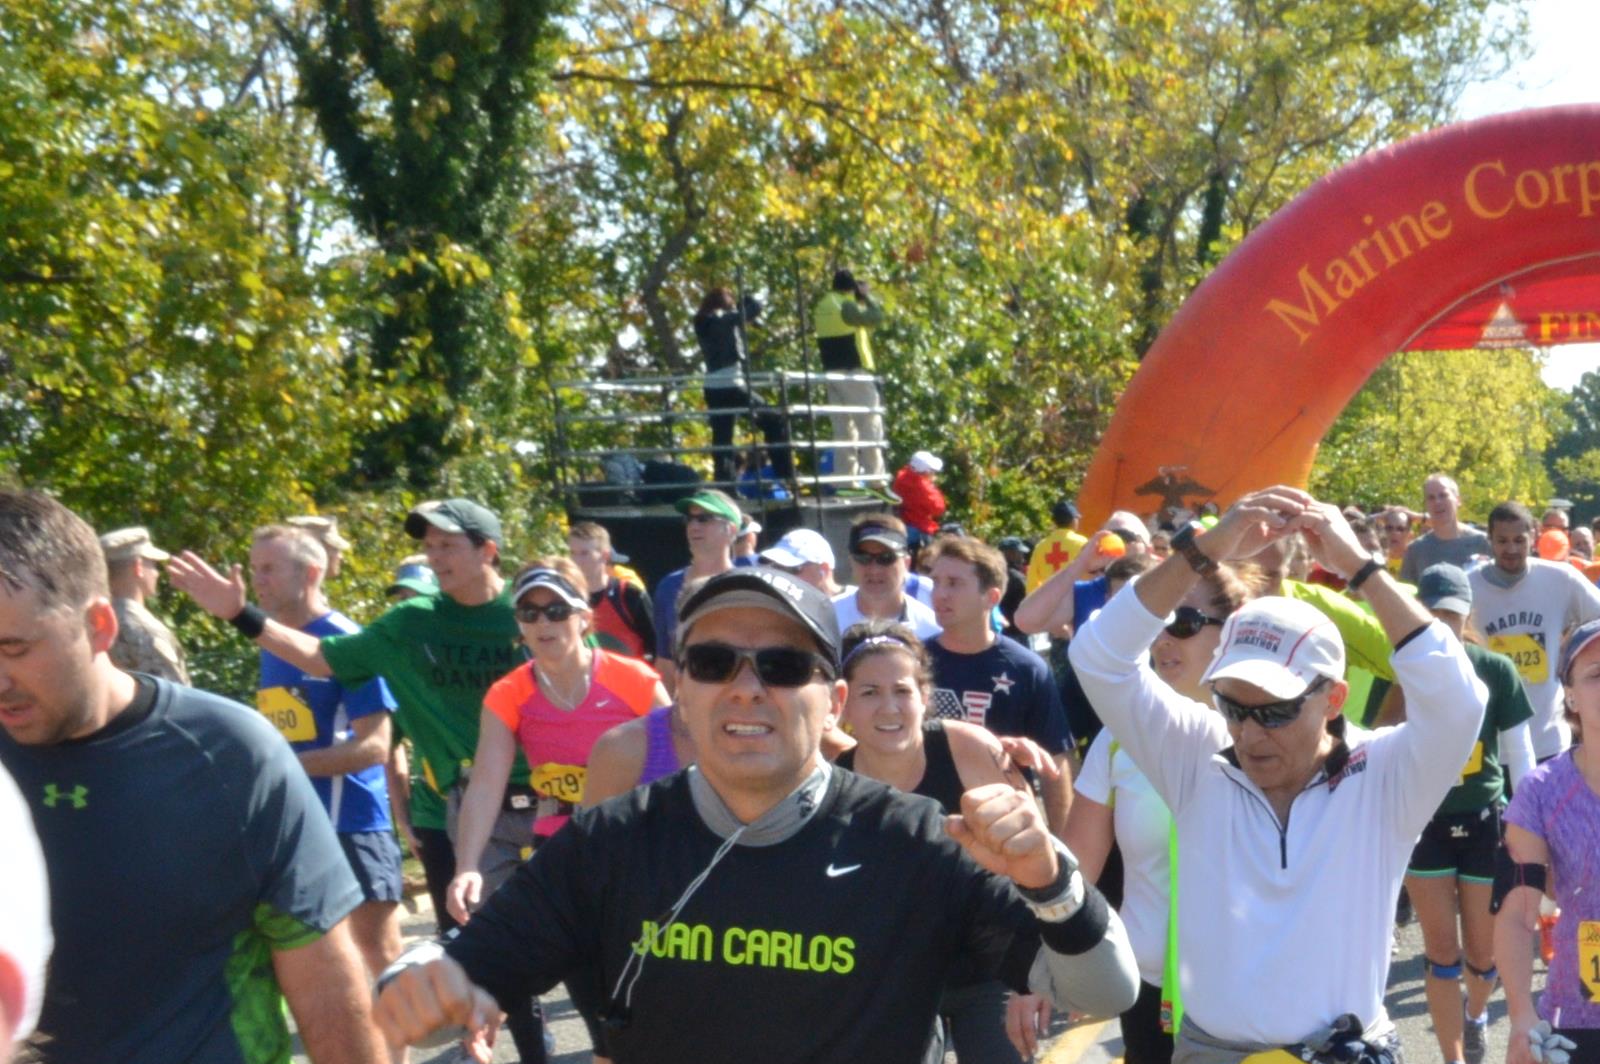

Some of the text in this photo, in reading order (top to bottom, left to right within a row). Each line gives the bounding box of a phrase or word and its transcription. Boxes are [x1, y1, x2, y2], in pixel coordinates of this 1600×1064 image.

[1264, 200, 1453, 346] Marine
[1485, 611, 1543, 635] MADRID
[1504, 649, 1541, 667] 423
[632, 920, 856, 974] JUAN CARLOS
